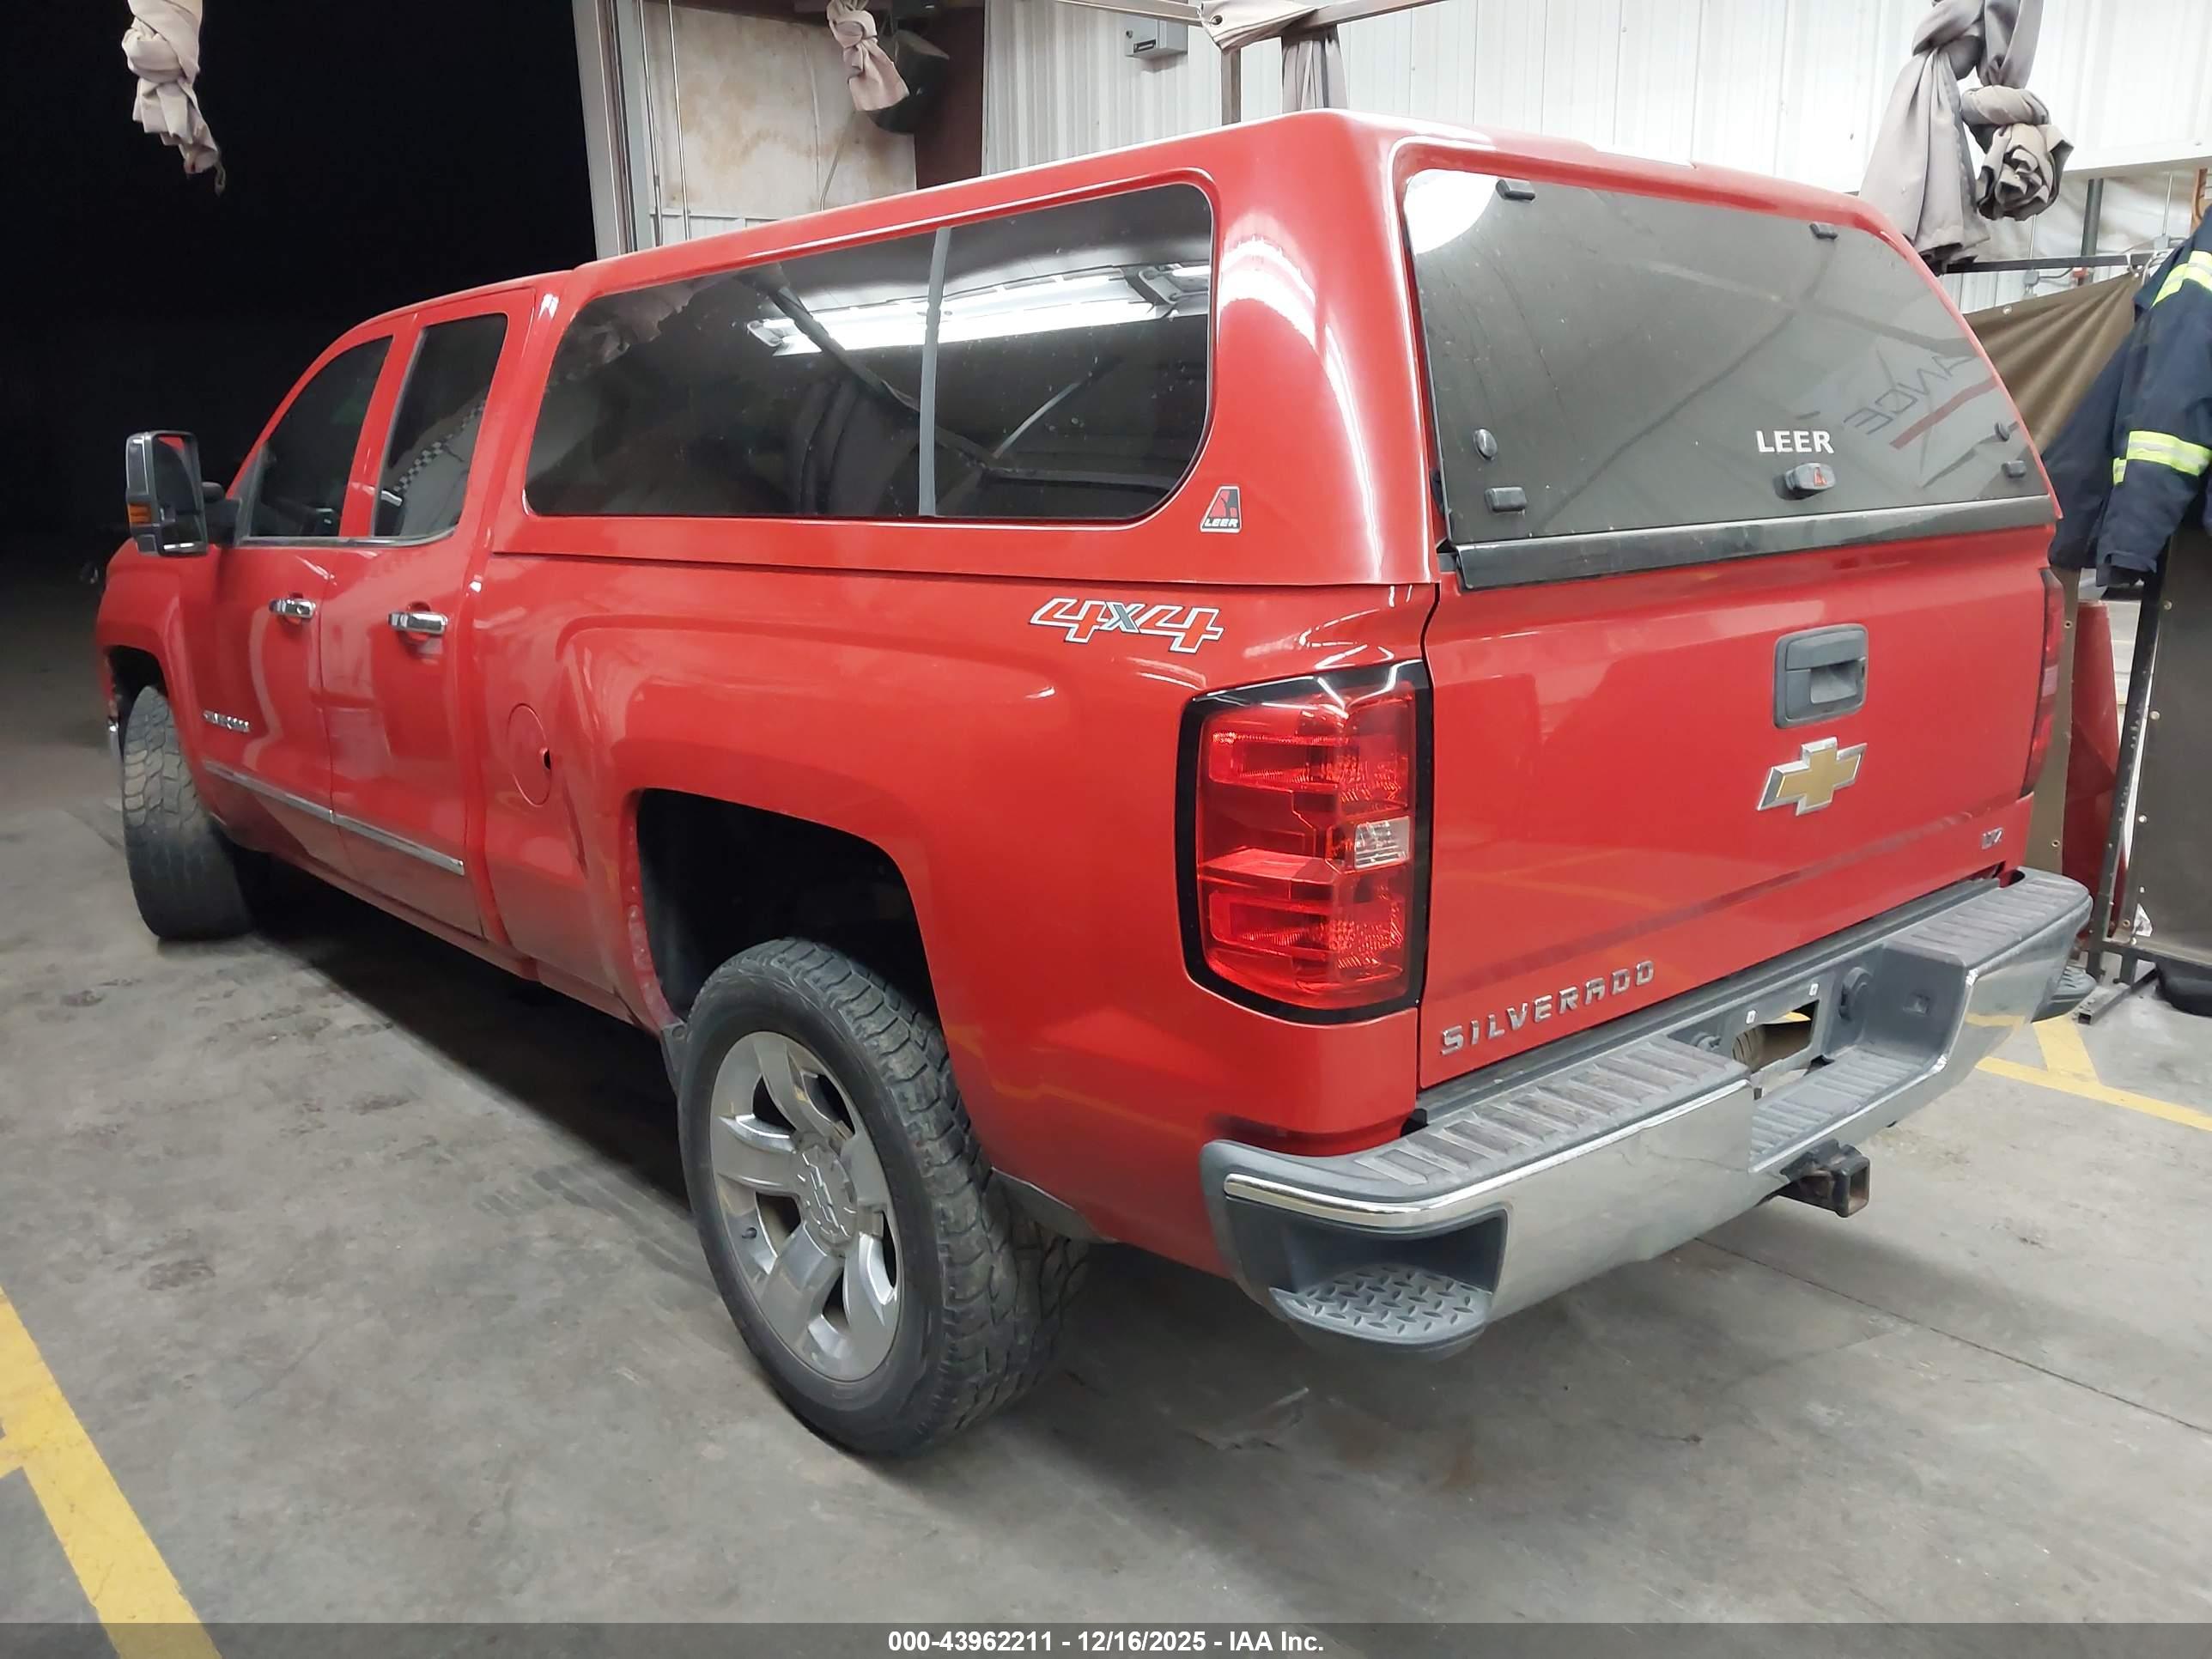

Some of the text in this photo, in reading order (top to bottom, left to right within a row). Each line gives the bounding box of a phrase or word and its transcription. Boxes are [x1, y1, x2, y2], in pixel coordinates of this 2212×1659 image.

[1755, 429, 1835, 454] LEER
[1204, 517, 1239, 528] LEER
[1439, 960, 1655, 1055] SILVERADO
